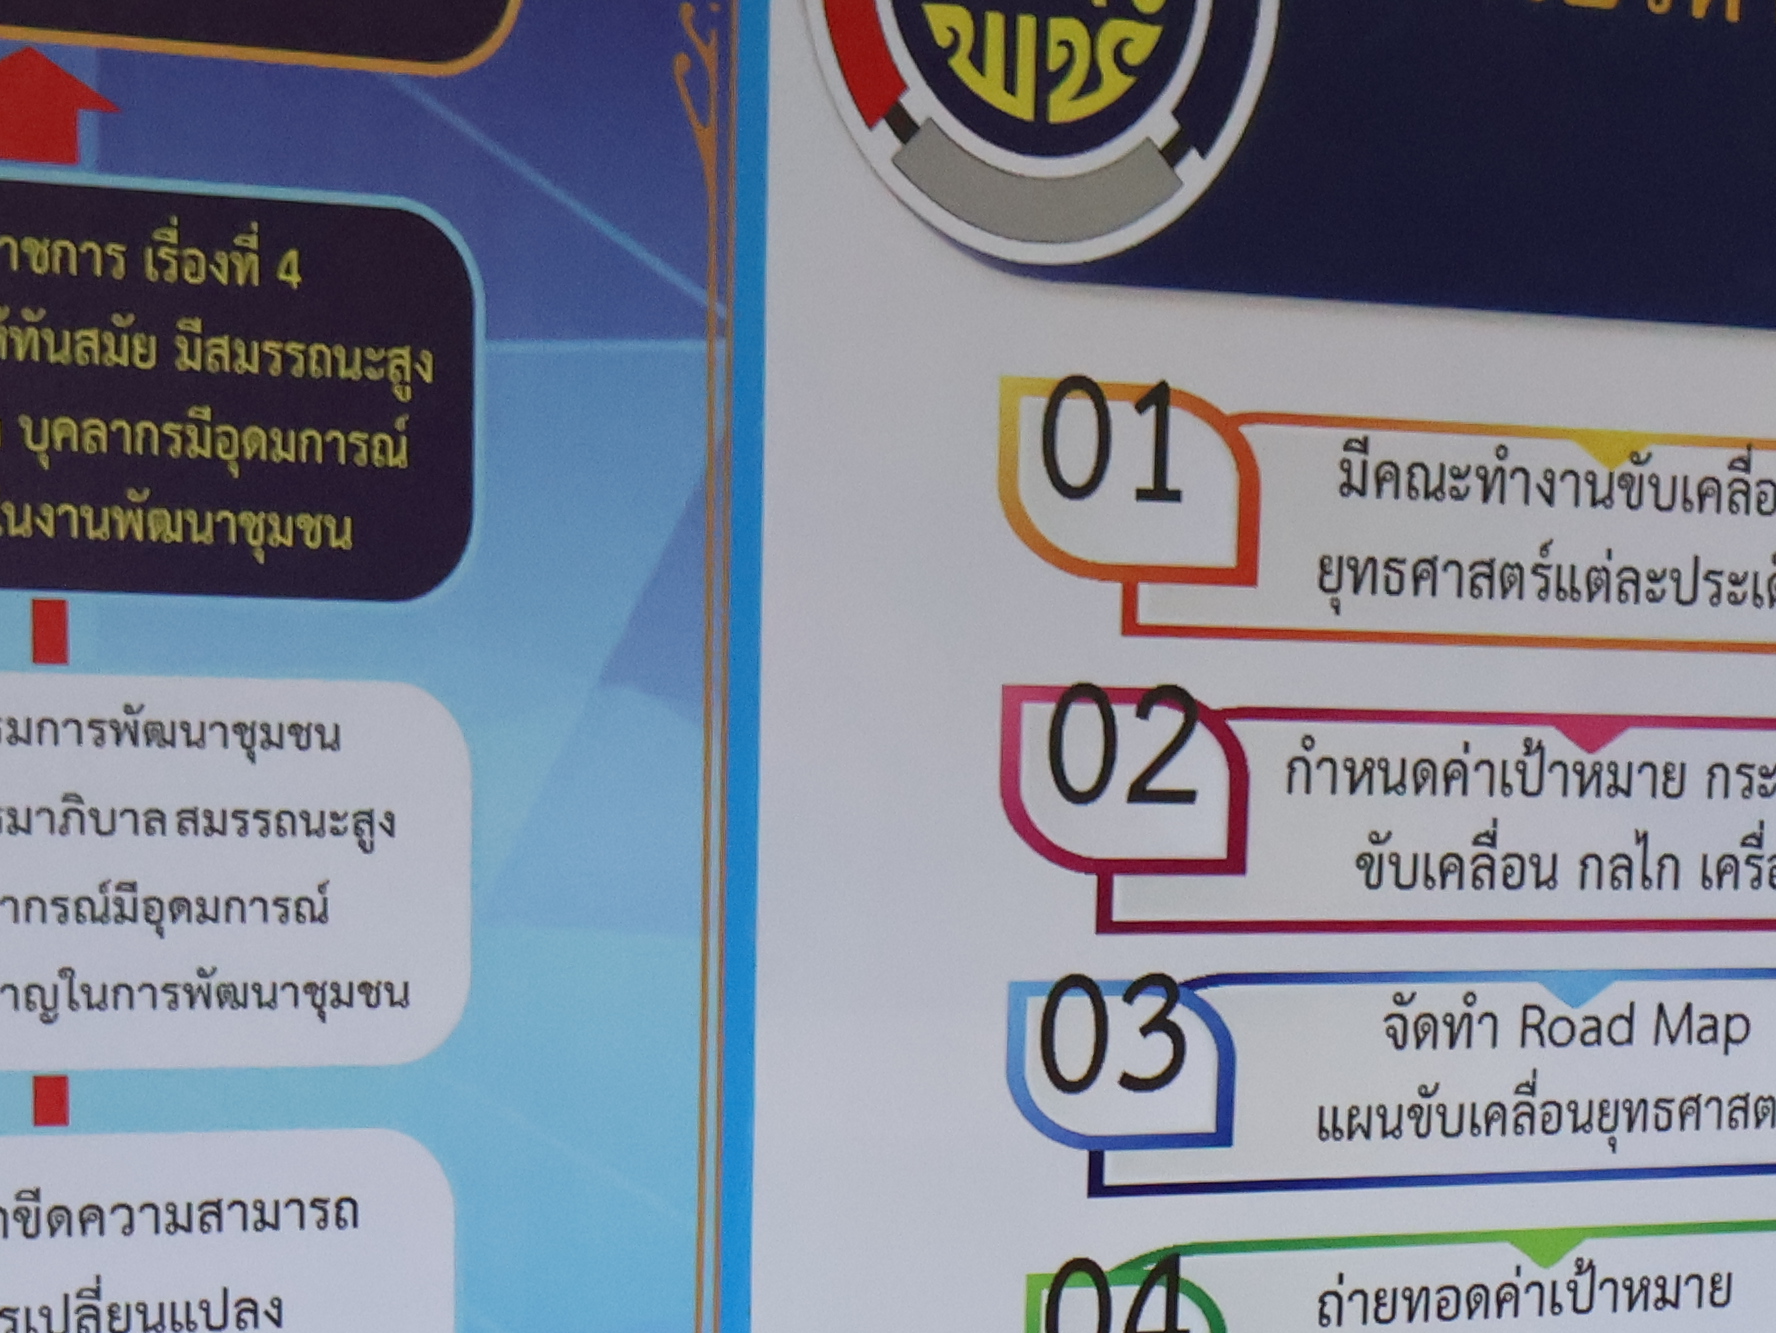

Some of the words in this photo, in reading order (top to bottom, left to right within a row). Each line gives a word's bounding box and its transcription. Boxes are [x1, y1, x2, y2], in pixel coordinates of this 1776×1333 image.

[145, 216, 259, 286] เรื่องที่
[277, 249, 302, 289] 4
[175, 317, 433, 402] มีสมรรถนะสูง
[18, 405, 409, 478] บุคลากรมีอุดมการณ์
[1042, 375, 1182, 502] 01
[1048, 682, 1199, 804] 02
[1287, 734, 1686, 799] กำหนดค่าเป้าหมาย
[1355, 817, 1558, 890] ขับเคลื่อน
[1579, 829, 1680, 890] กลไก
[1040, 973, 1188, 1093] 03
[1383, 991, 1498, 1050] จัดทำ
[1520, 1001, 1635, 1048] Road
[1654, 1002, 1751, 1056] Map
[1318, 1257, 1732, 1327] ถ่ายทอดค่าเป้าหมาย
